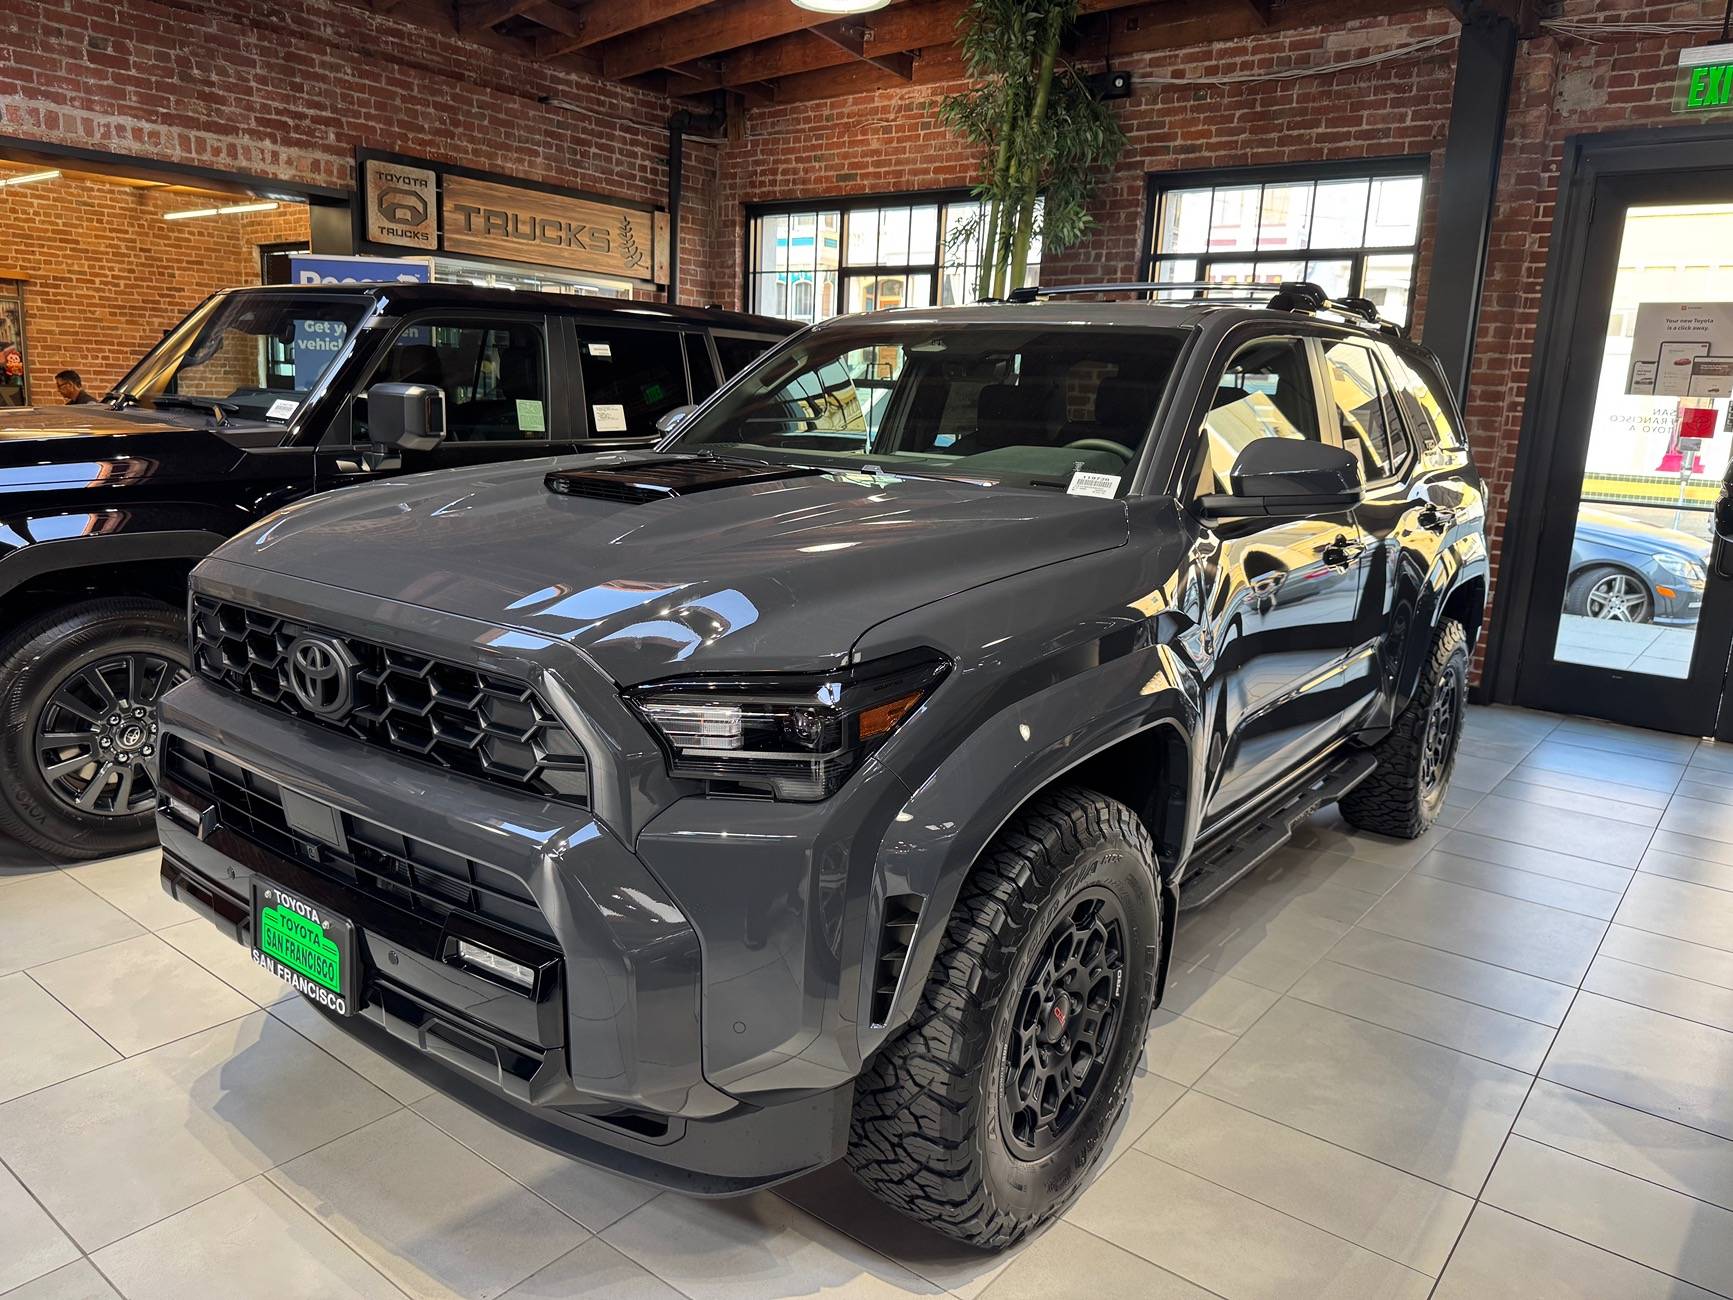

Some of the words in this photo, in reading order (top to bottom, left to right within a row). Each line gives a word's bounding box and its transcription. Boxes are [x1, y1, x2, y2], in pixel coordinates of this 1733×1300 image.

[1688, 65, 1733, 106] EXI
[376, 171, 428, 188] TOYOTA
[378, 226, 429, 241] TRUCKS
[454, 204, 610, 253] TRUCKS
[304, 320, 330, 333] Get
[298, 338, 343, 351] vehicl
[274, 889, 320, 924] TOYOTA
[280, 914, 321, 948] TOYOTA
[266, 927, 284, 954] SAN
[285, 938, 335, 982] FRANCISCO
[252, 949, 275, 974] SAN
[277, 963, 346, 1015] FRANCISCO
